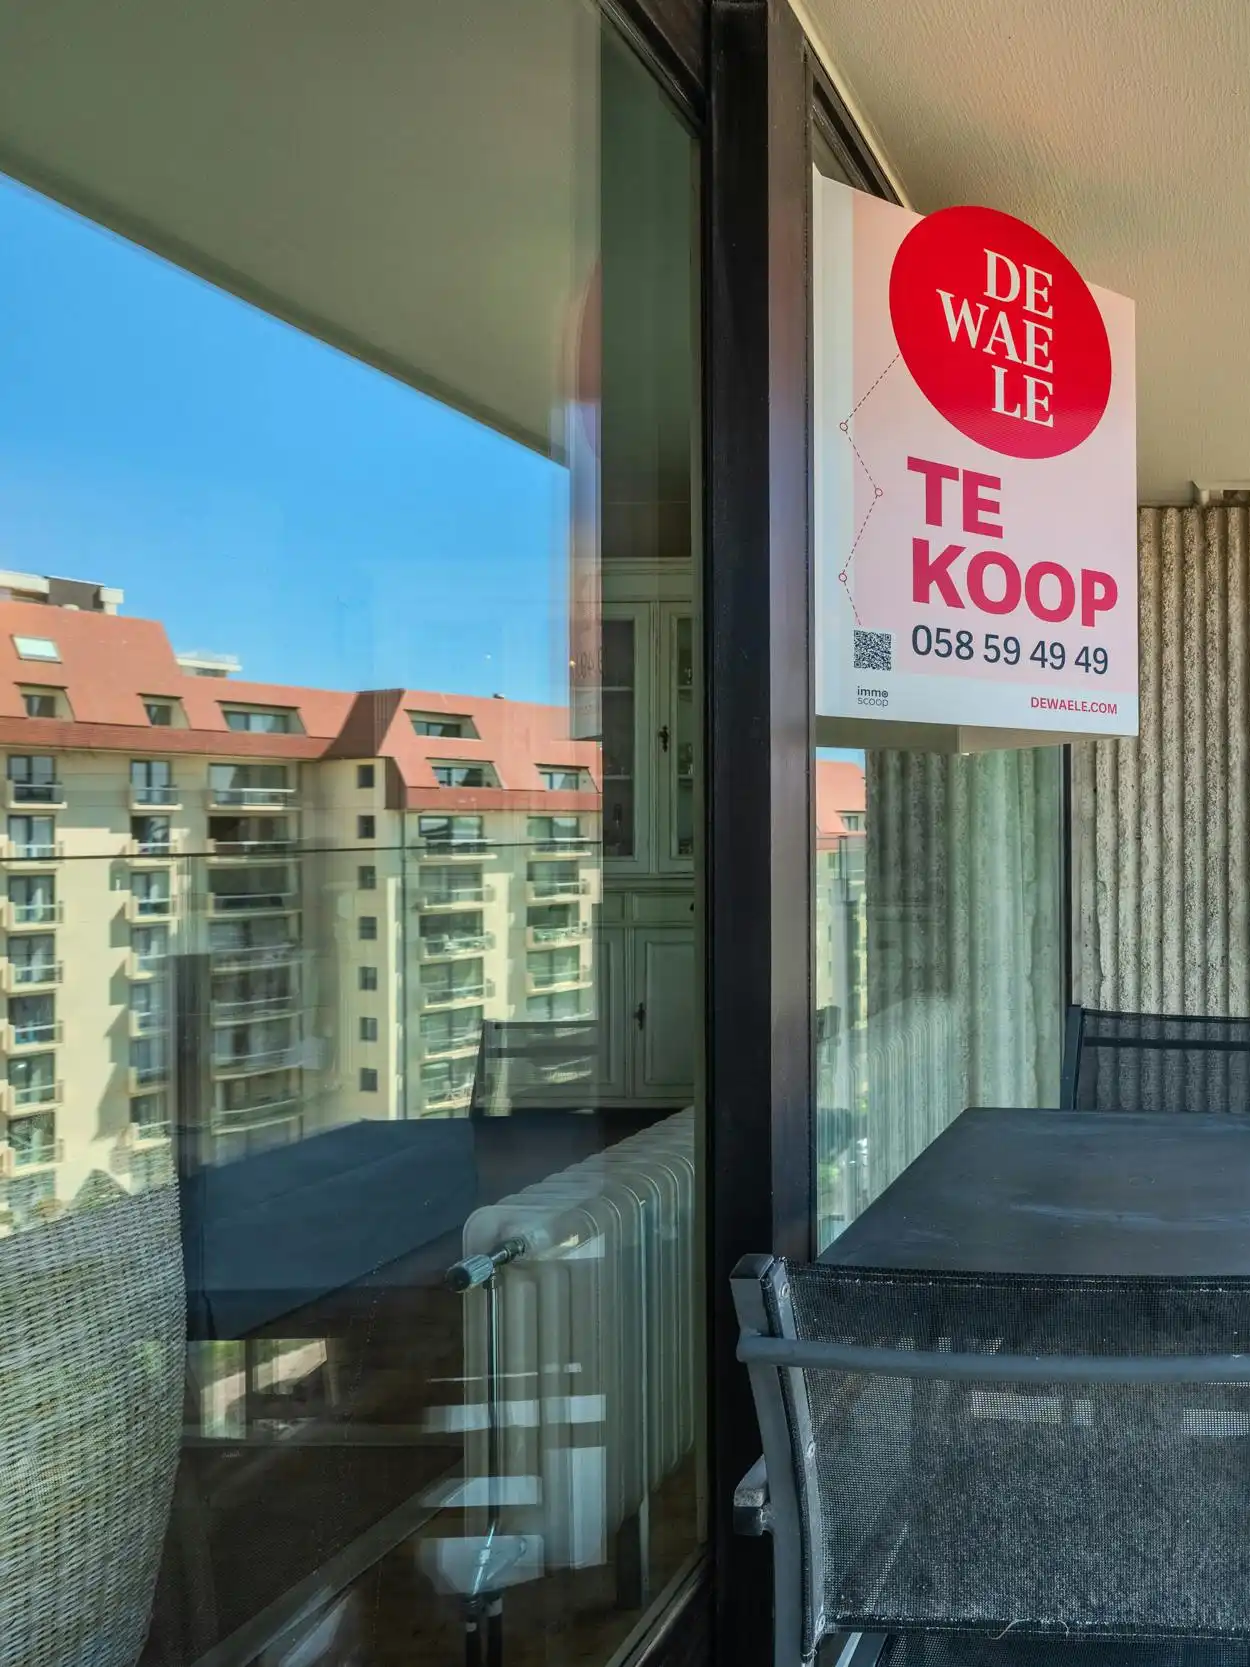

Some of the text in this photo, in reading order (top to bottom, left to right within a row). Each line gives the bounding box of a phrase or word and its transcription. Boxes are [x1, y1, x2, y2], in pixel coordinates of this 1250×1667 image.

[983, 248, 1053, 319] DE
[936, 288, 1053, 374] WAE
[991, 364, 1054, 428] LE
[907, 455, 1003, 539] TE
[912, 536, 1118, 627] KOOP
[912, 624, 1109, 675] 058 59 49 49
[857, 685, 889, 698] immo
[857, 697, 889, 708] scoop
[1030, 696, 1118, 714] DEWAELE.COM
